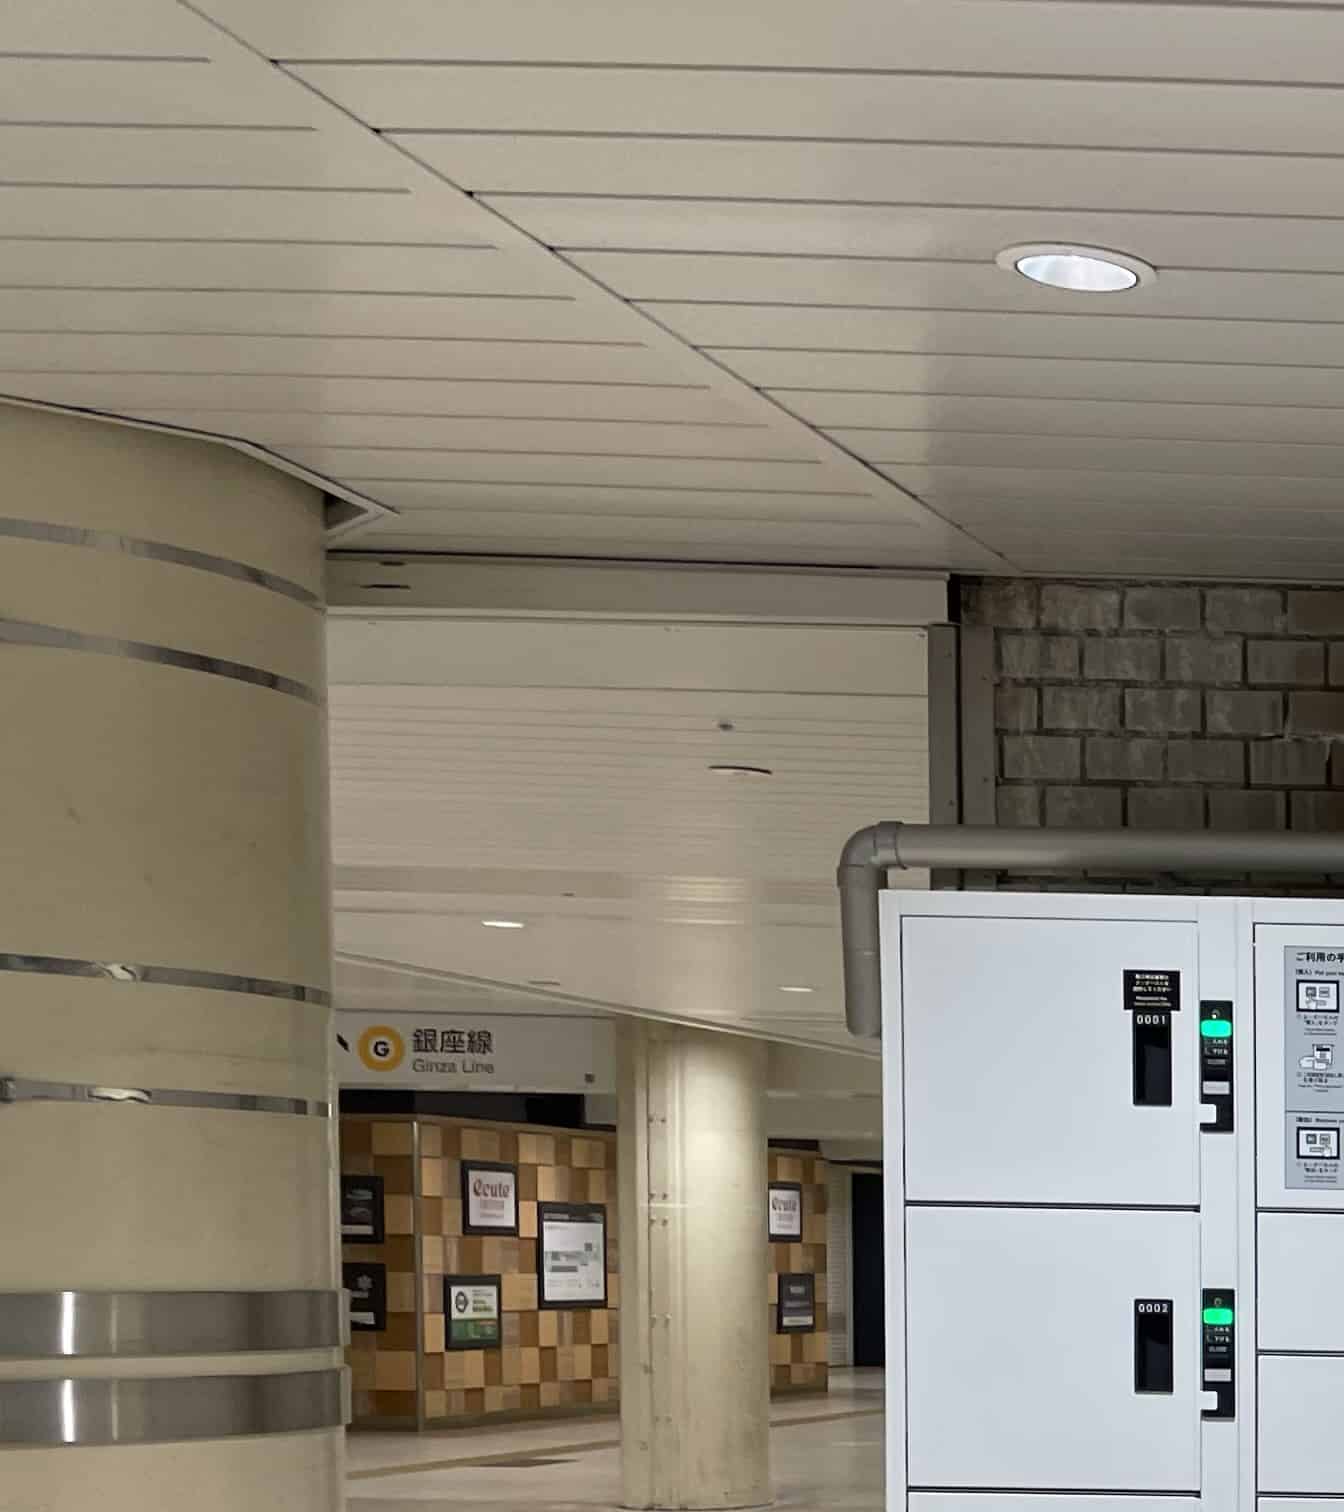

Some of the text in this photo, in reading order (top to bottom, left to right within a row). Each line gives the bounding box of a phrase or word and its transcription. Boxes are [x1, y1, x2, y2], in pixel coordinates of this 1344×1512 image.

[1138, 1014, 1165, 1025] 0001
[373, 1041, 390, 1057] G
[412, 1029, 494, 1055] 銀座線
[412, 1059, 495, 1074] Ginza Line
[1138, 1303, 1168, 1313] 0002
